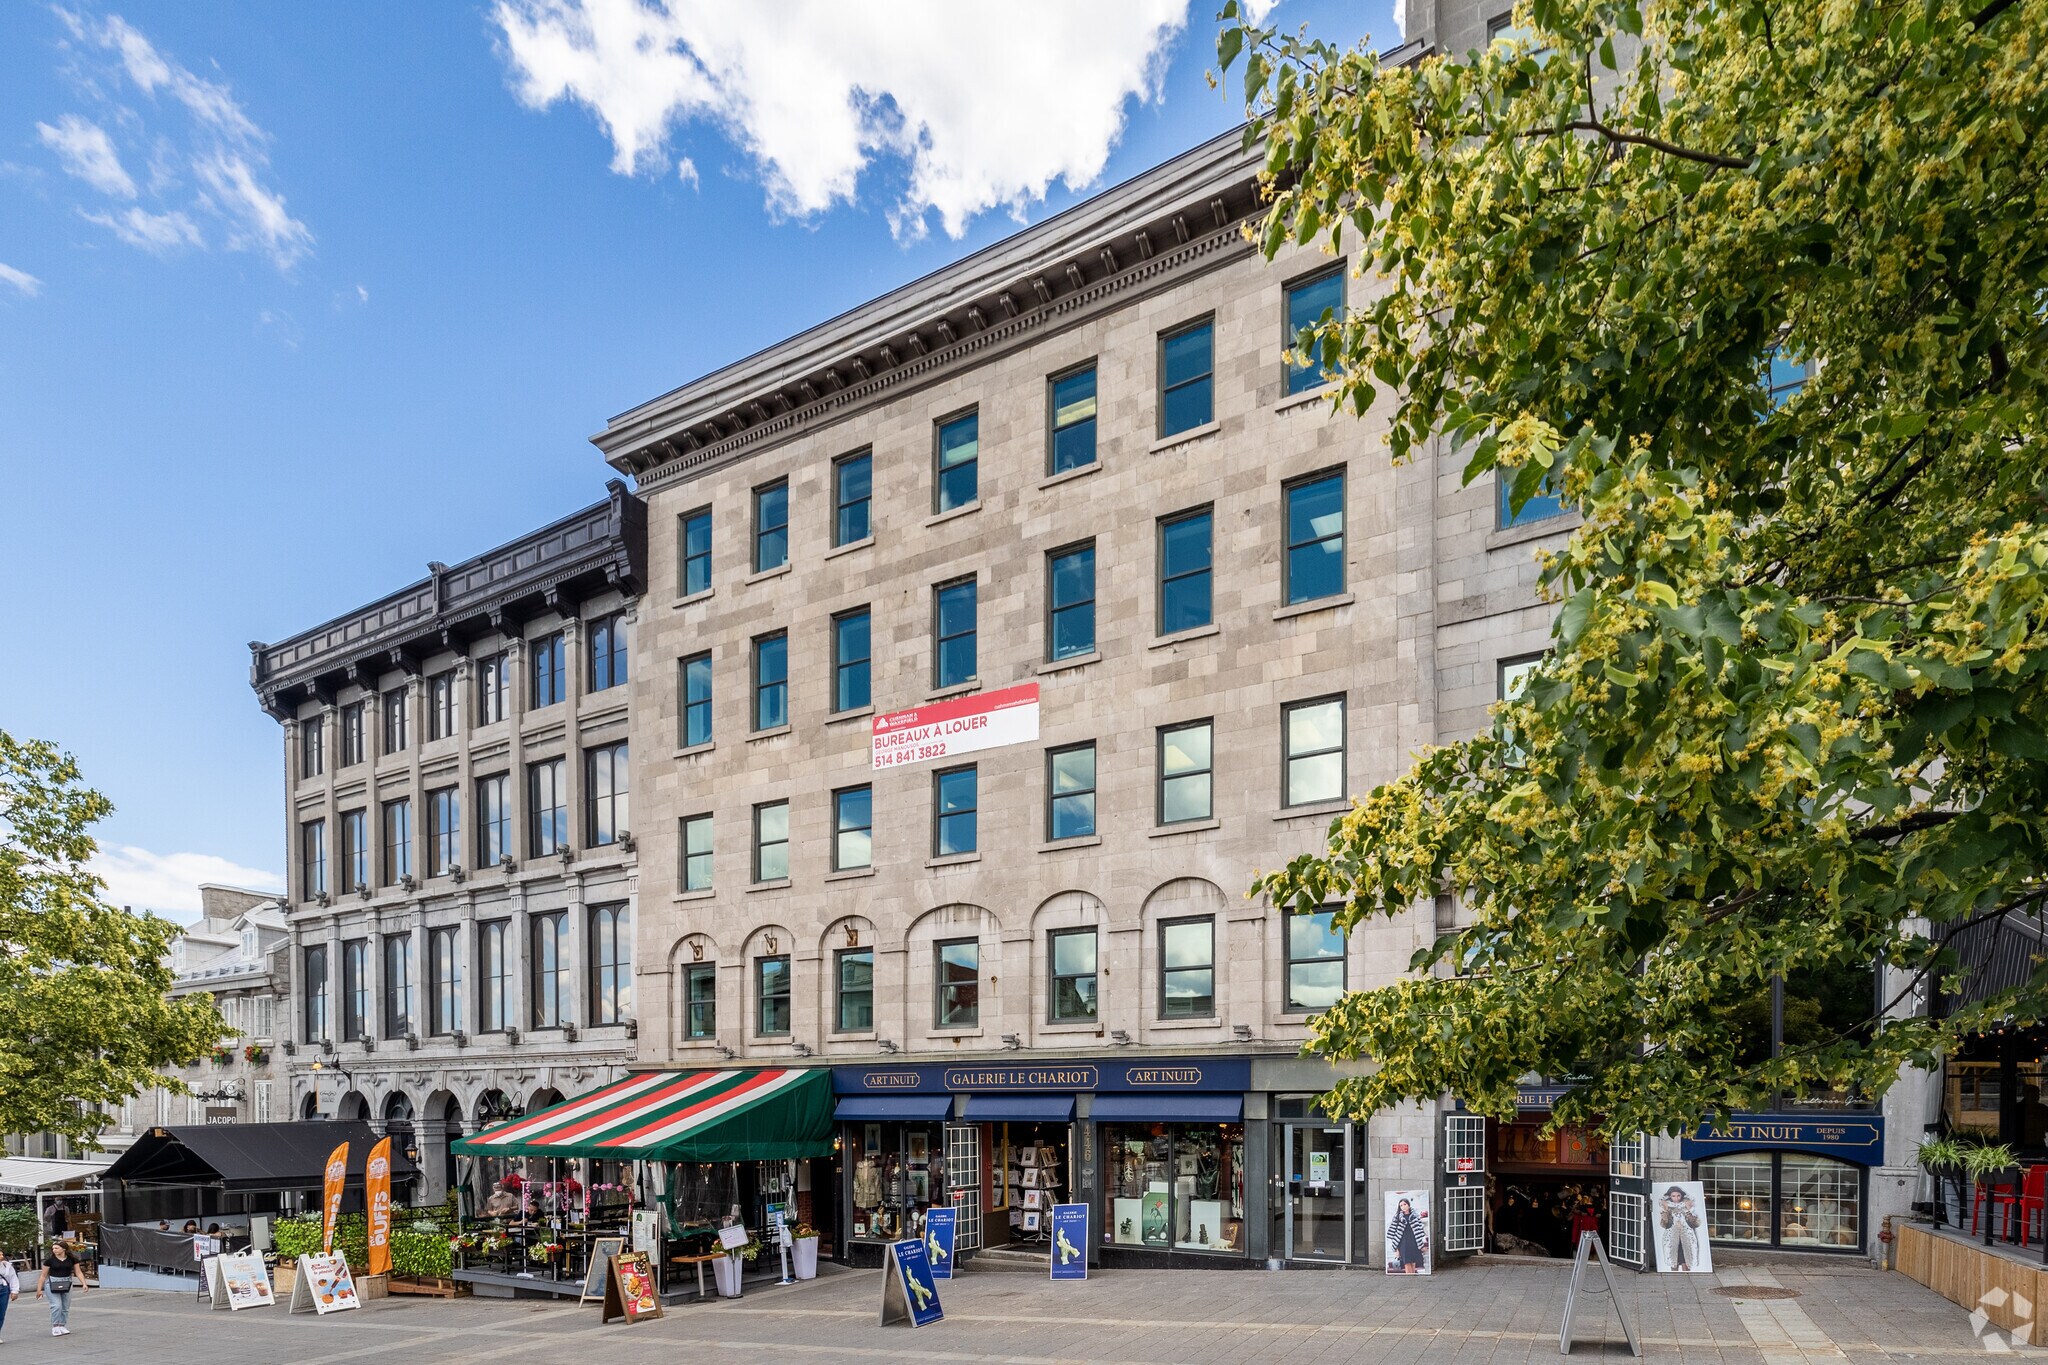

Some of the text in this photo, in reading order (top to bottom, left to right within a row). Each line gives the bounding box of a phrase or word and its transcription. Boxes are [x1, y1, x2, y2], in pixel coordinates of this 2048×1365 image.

[874, 715, 988, 750] BUREAUX À LOUER
[875, 743, 946, 768] 514 841 3822
[870, 1075, 916, 1085] ART INUIT
[952, 1071, 1090, 1085] GALERIE LE CHARIOT
[1135, 1070, 1196, 1081] ART INUIT
[1538, 1095, 1552, 1104] LE
[206, 1116, 237, 1125] JACOPO
[1751, 1126, 1802, 1139] INUIT
[373, 1191, 388, 1246] PUFFS
[904, 1247, 923, 1257] CHARIOT
